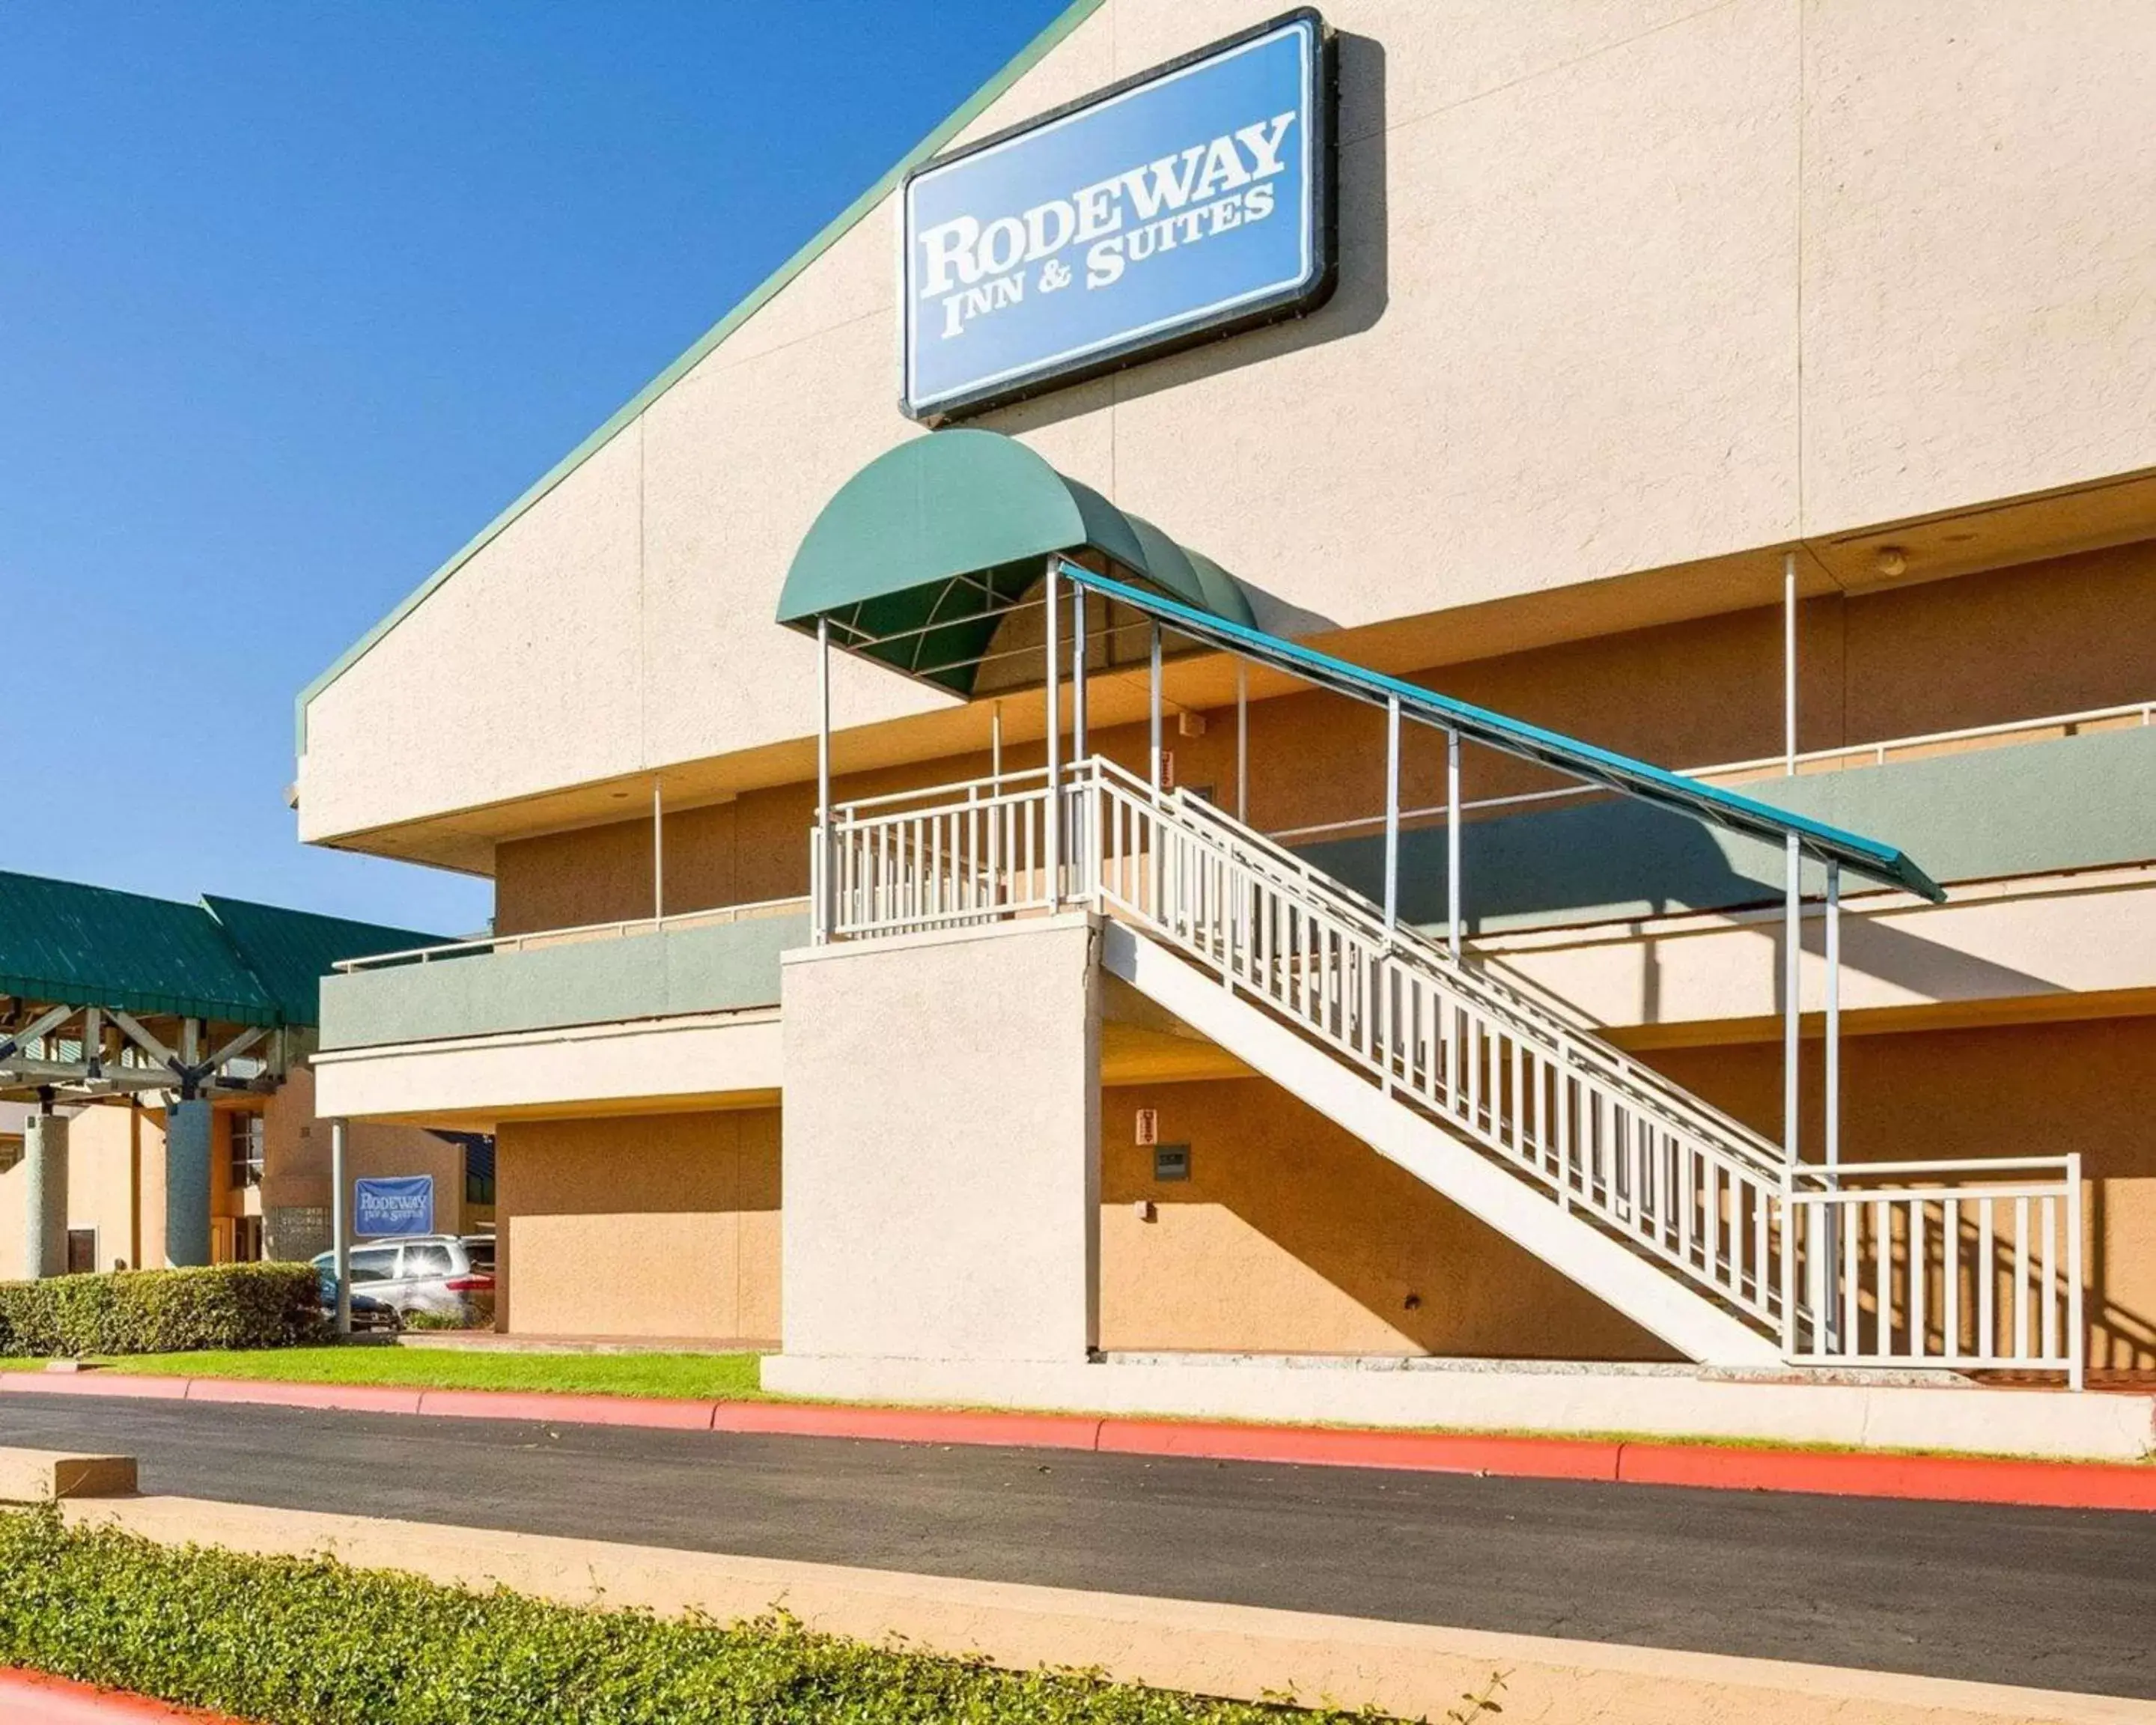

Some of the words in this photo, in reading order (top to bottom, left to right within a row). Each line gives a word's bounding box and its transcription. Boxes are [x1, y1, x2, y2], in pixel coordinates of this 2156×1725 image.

[919, 111, 1296, 299] RODEWAY
[942, 272, 1026, 339] INN
[1038, 259, 1071, 293] &
[1086, 183, 1274, 290] SUITES
[360, 1193, 427, 1209] RODEWAY
